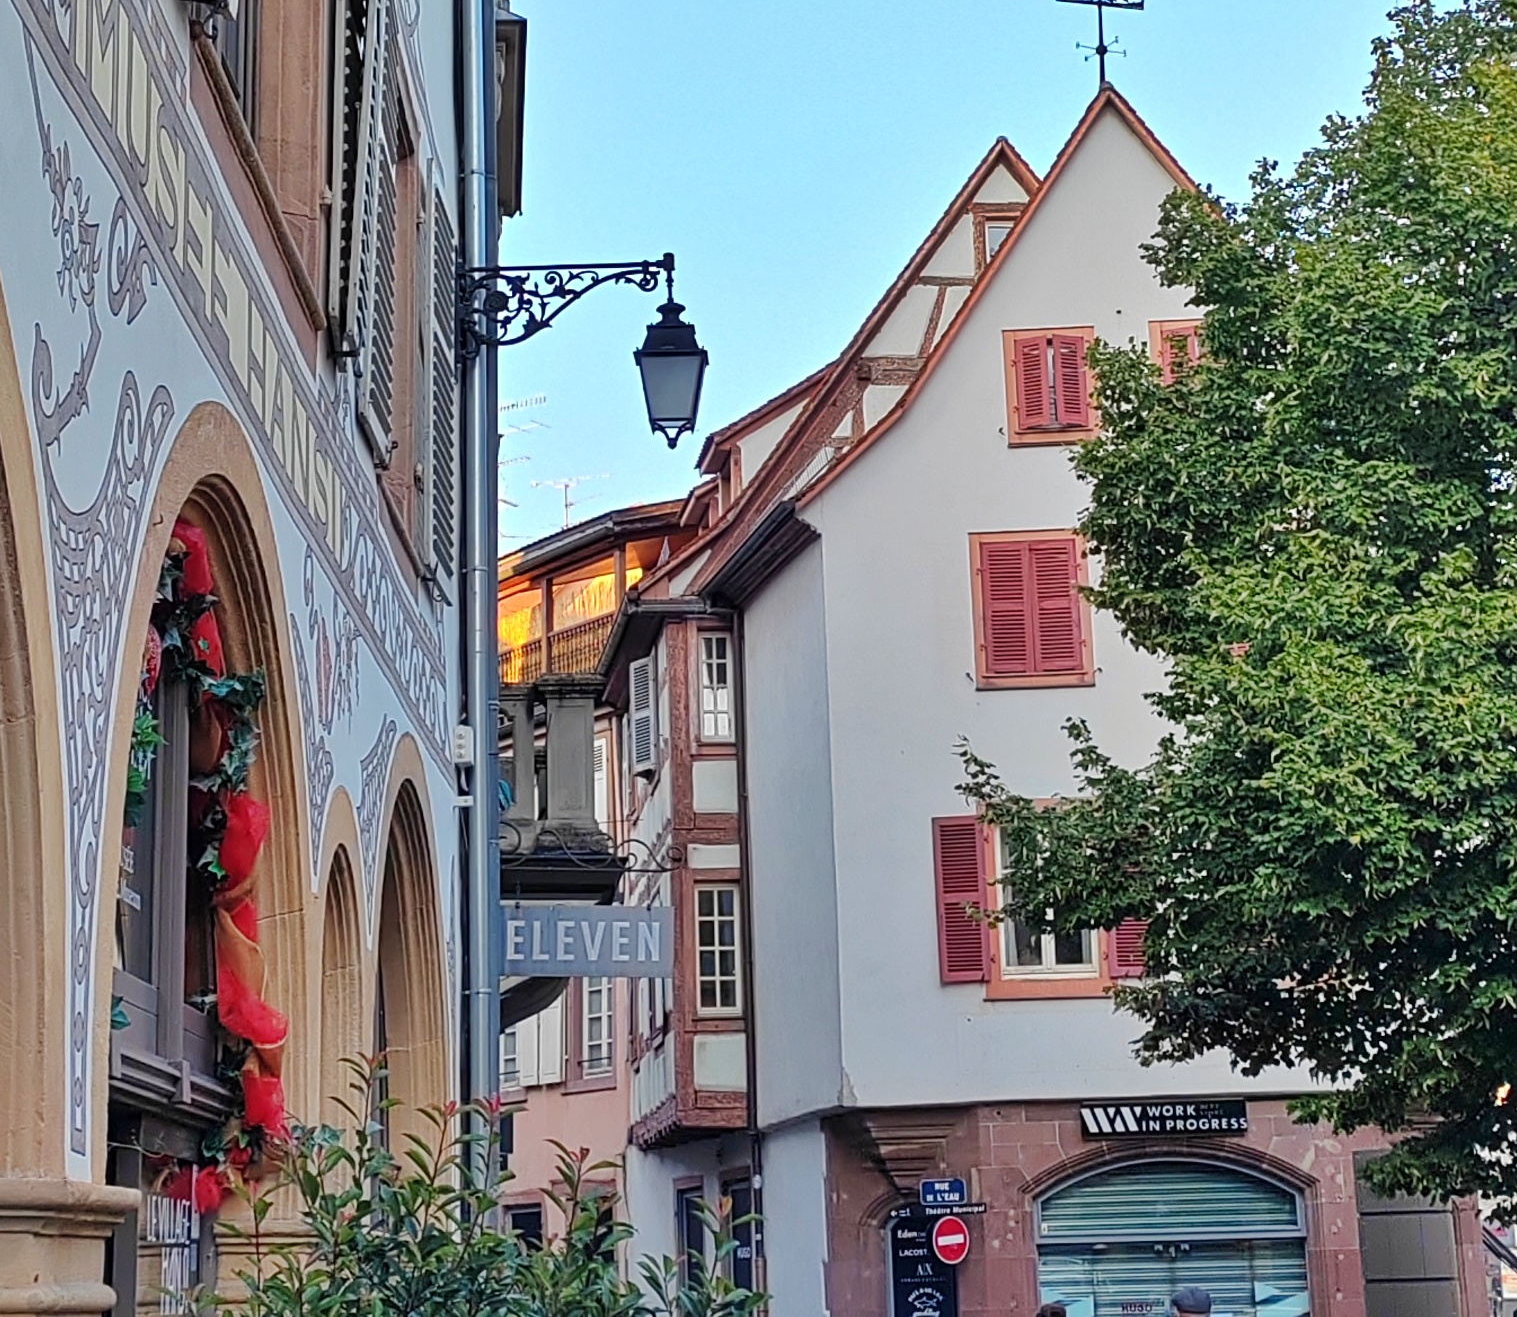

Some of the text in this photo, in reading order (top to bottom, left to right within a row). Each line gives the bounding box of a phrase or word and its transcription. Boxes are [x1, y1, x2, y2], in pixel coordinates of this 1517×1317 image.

[247, 292, 338, 564] HANSI
[506, 920, 660, 962] ELEVEN
[1147, 1104, 1197, 1117] WORK
[1142, 1117, 1248, 1132] IN PROGRESS
[934, 1183, 950, 1191] RUE
[926, 1194, 934, 1202] DE
[899, 1249, 928, 1257] LACOST
